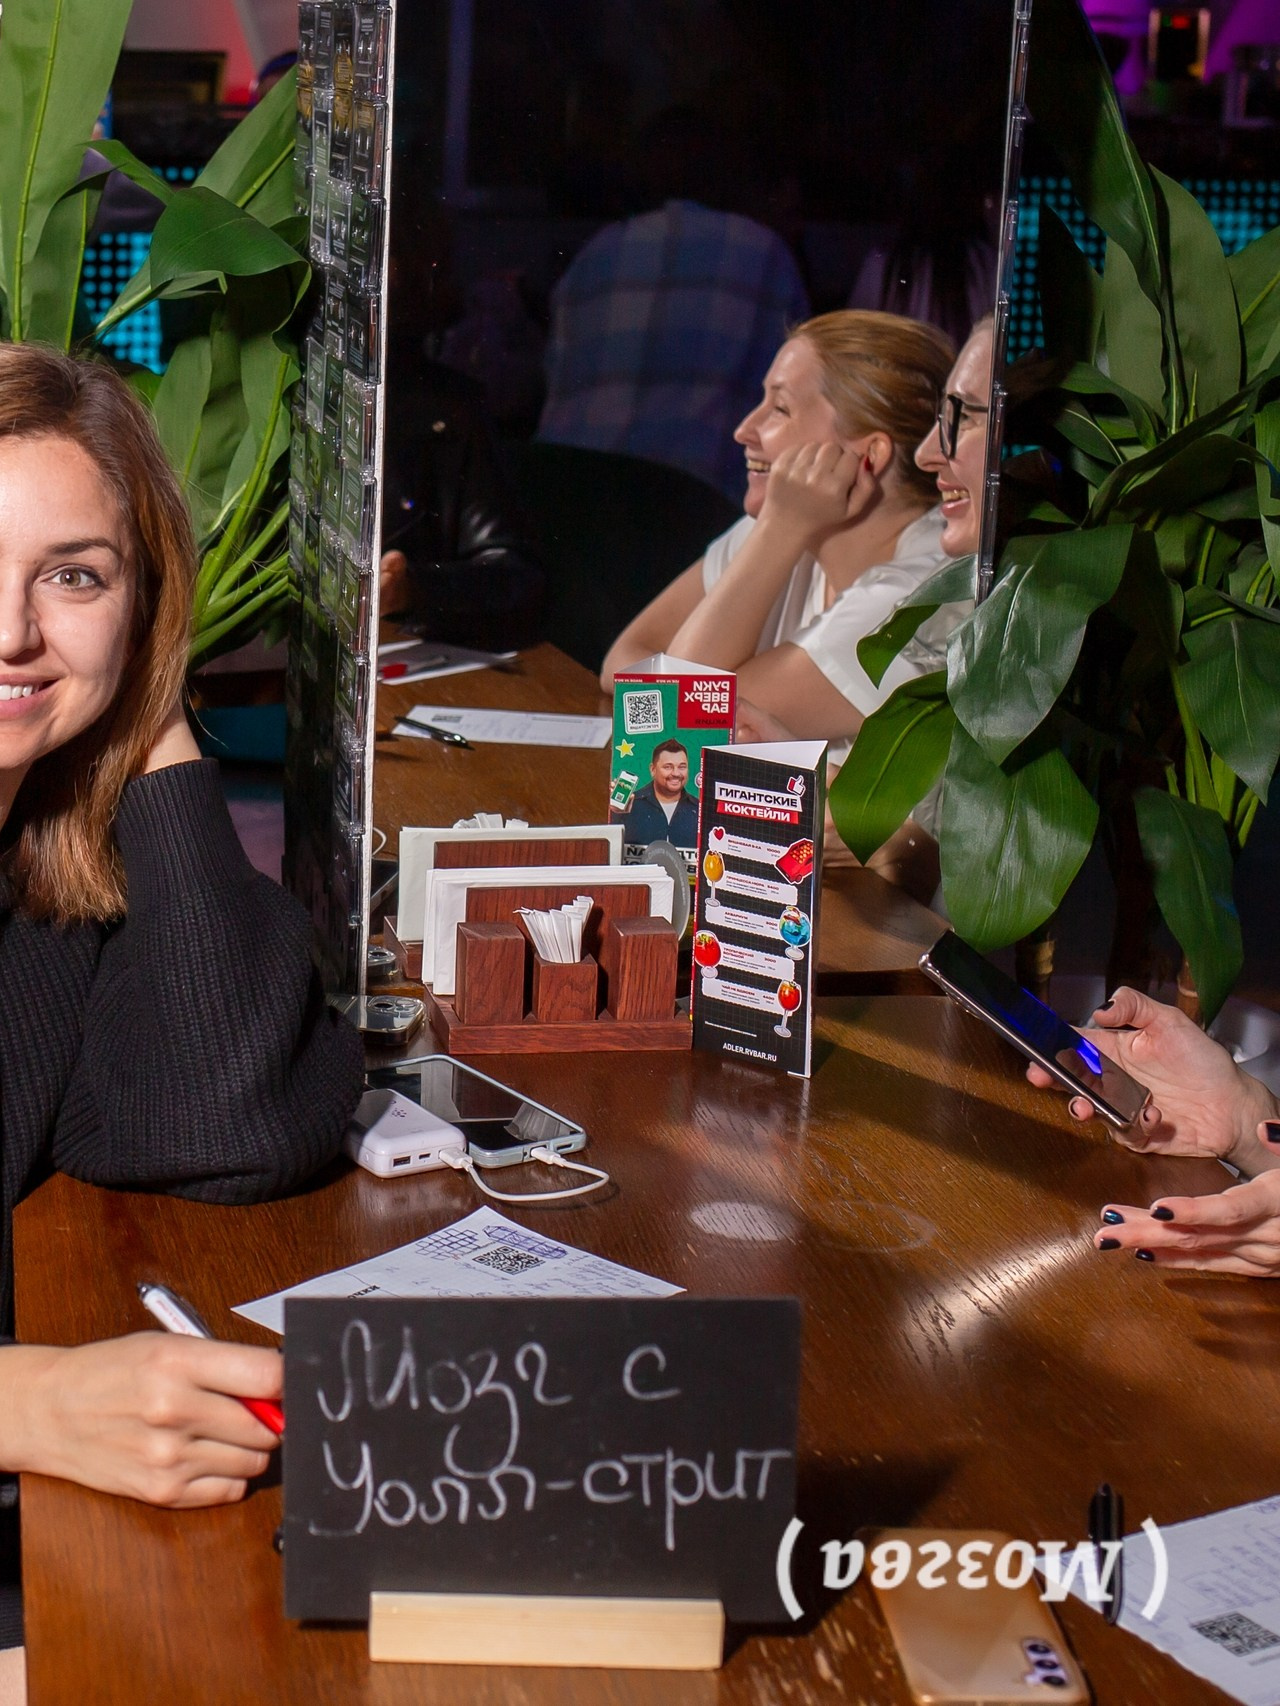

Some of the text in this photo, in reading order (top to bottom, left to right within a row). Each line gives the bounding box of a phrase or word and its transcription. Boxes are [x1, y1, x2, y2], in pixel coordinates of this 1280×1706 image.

[719, 786, 798, 808] ГИГАНТСКИЕ
[724, 803, 791, 822] КОКТЕЙЛИ
[723, 1042, 777, 1062] ADLER.RVBAR.RU
[317, 1319, 572, 1478] Мозг
[308, 1440, 793, 1552] Уолл-стрит
